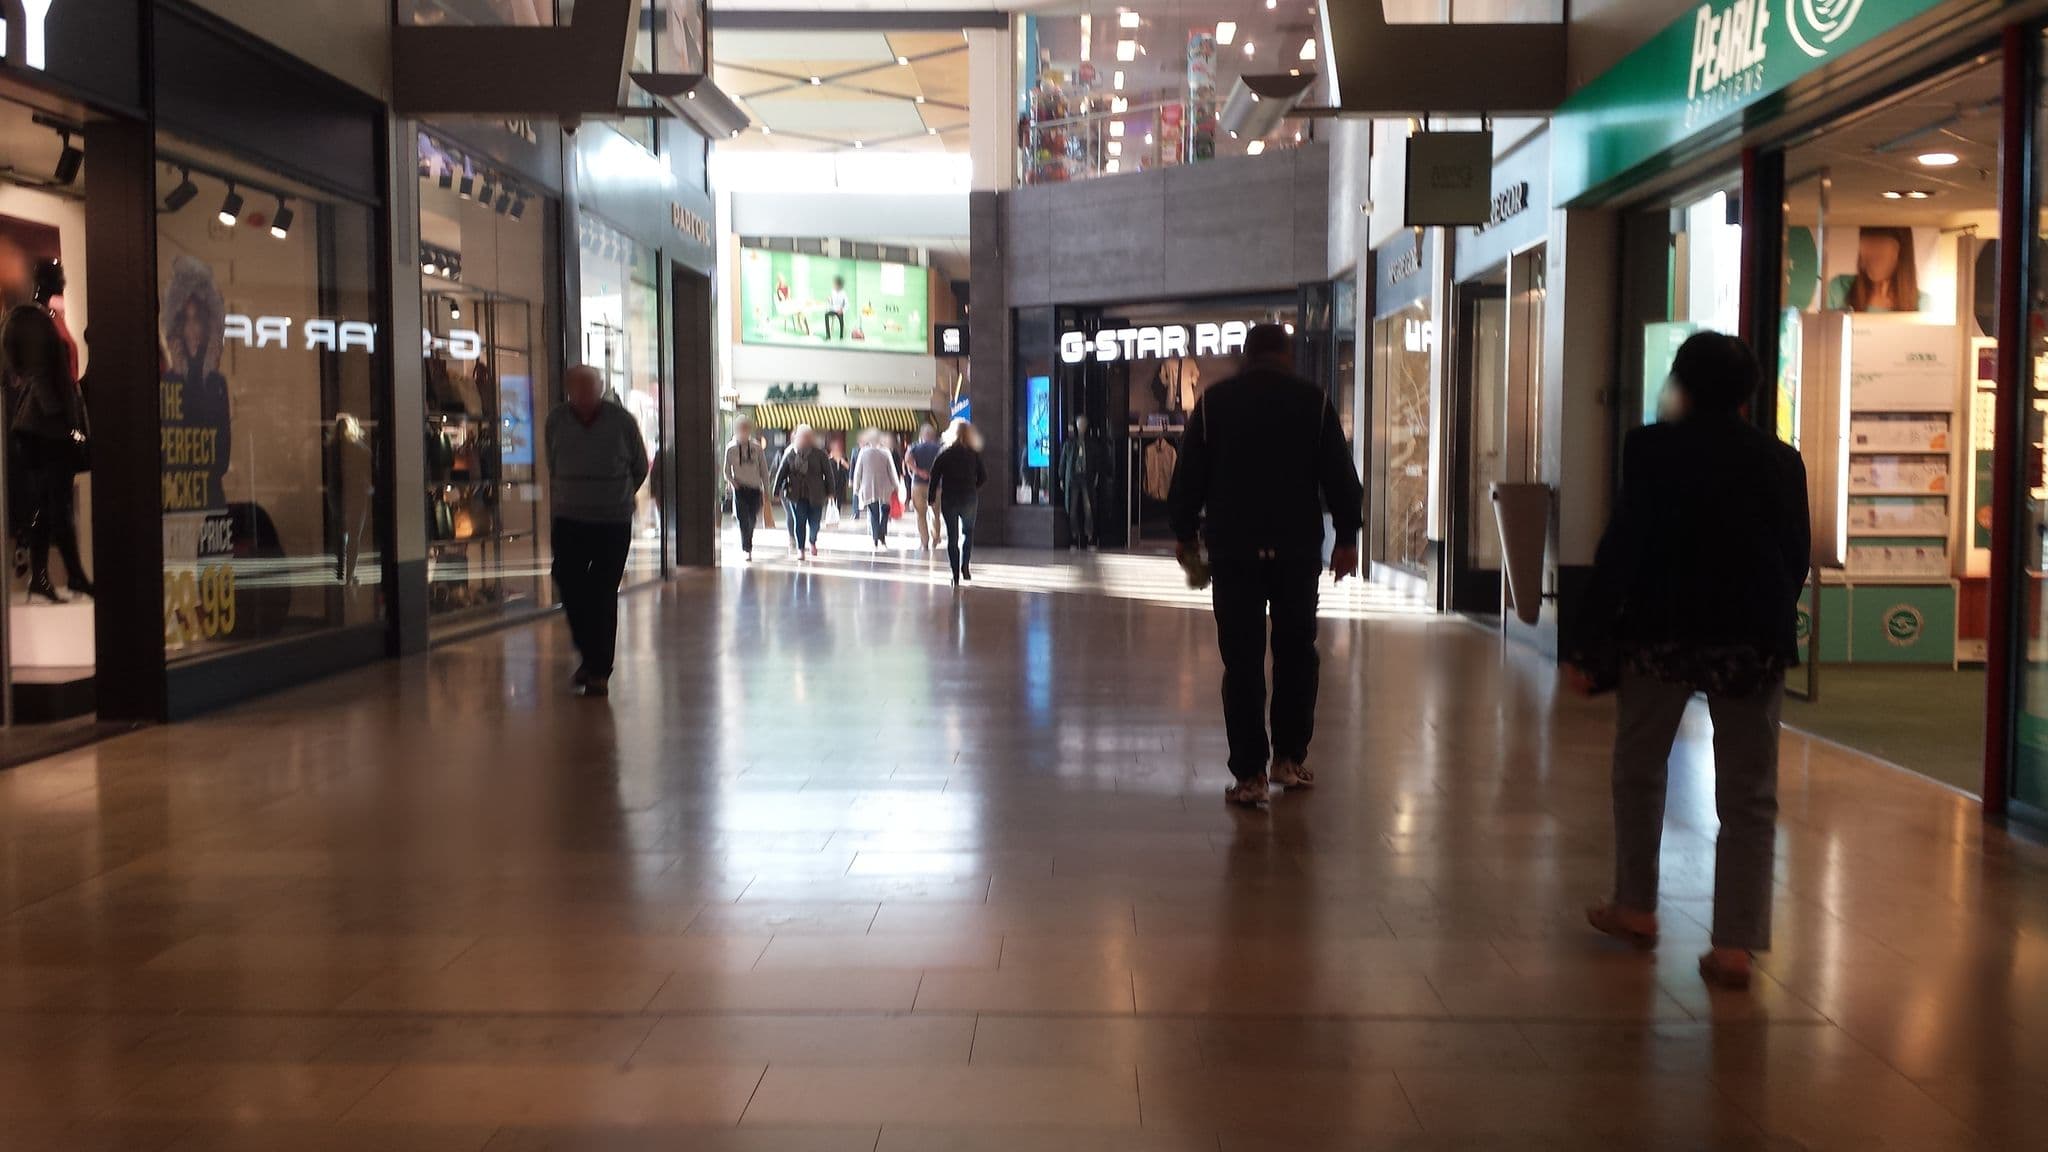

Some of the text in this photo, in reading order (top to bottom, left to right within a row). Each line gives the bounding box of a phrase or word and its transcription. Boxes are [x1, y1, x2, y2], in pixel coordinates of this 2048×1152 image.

[1688, 0, 1770, 100] PEARLE
[1196, 320, 1256, 357] RA
[160, 427, 217, 465] PERFECT
[200, 518, 234, 552] PRICE
